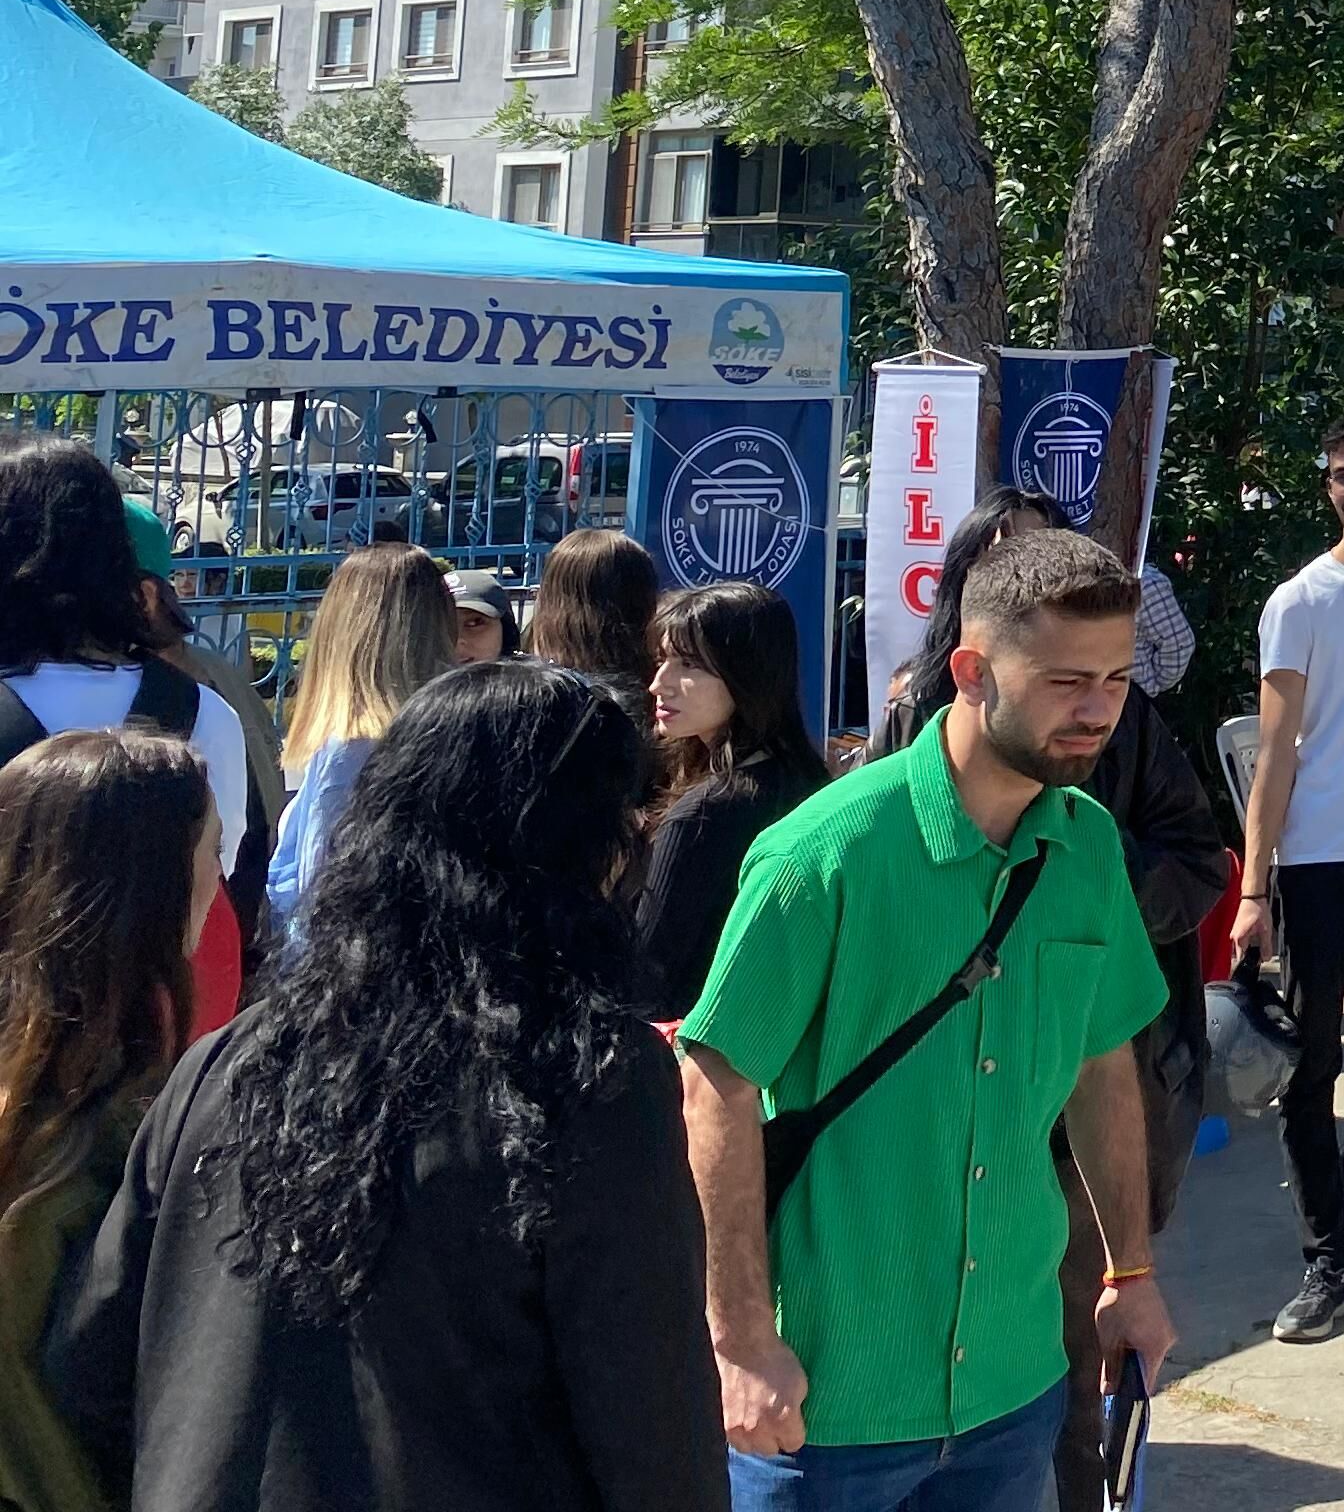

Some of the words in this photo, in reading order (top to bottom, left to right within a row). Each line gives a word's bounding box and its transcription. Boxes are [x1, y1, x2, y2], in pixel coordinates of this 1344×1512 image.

[206, 297, 672, 371] BELEDİYESİ
[734, 441, 760, 453] 1974
[768, 515, 799, 573] ODASI
